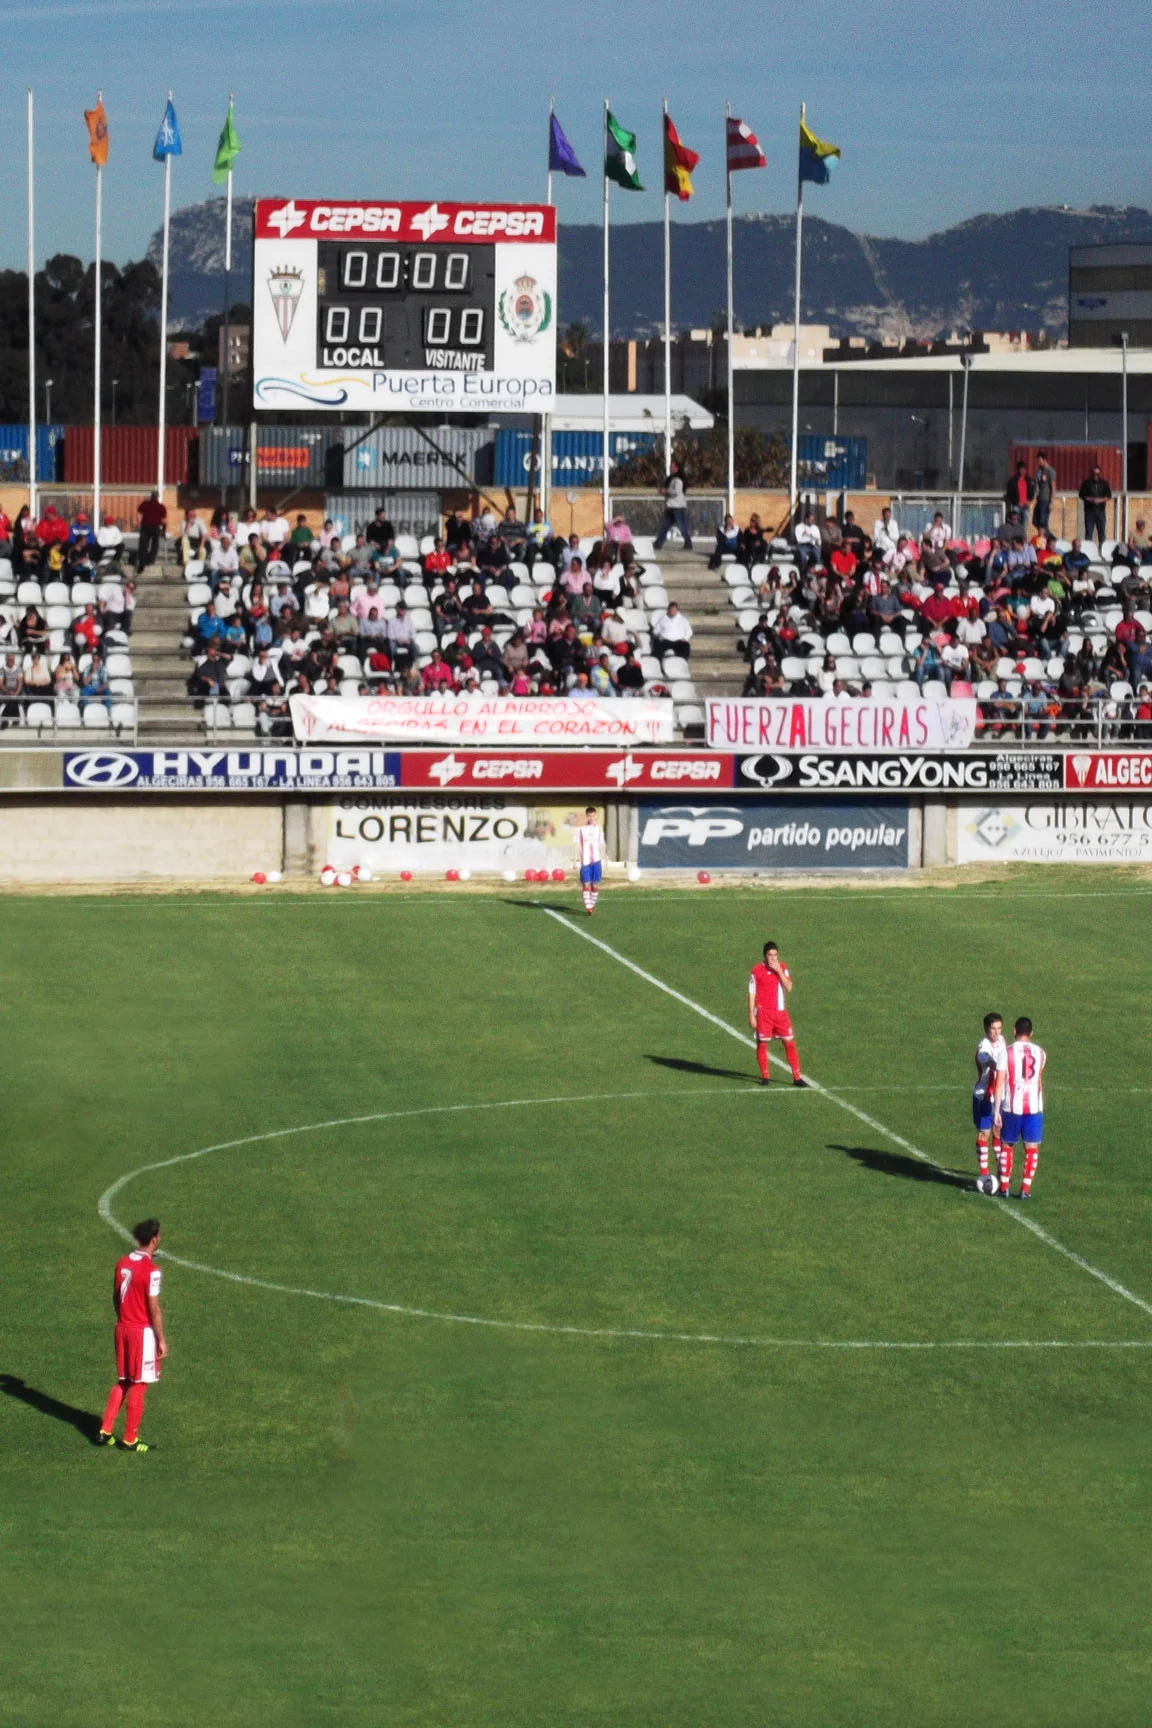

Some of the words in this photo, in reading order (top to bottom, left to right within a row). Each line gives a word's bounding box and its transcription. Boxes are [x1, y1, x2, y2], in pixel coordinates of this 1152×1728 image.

[310, 206, 401, 232] CEPSA
[453, 210, 544, 236] CEPSA
[344, 251, 469, 289] 00:00
[325, 306, 383, 344] 00
[426, 307, 484, 345] 00
[322, 347, 384, 368] LOCAL
[425, 348, 486, 371] VISITANTE
[371, 372, 456, 395] Puerta
[462, 372, 553, 398] Europa
[409, 397, 454, 410] Centro
[459, 397, 525, 410] Comercial
[382, 450, 467, 468] MAERSK
[543, 453, 618, 472] ANJI
[367, 699, 468, 716] ORGULLO
[458, 719, 487, 735] EN
[497, 719, 523, 735] EL
[709, 702, 929, 748] FUERZALGECIRAS
[153, 752, 385, 775] HYUNDAI
[472, 759, 544, 780] CEPSA
[650, 760, 721, 780] CEPSA
[335, 814, 519, 843] LORENZO
[747, 823, 821, 851] partido
[825, 823, 905, 851] popular
[1055, 833, 1091, 846] 956
[1097, 833, 1132, 846] 677
[120, 1268, 132, 1303] 7
